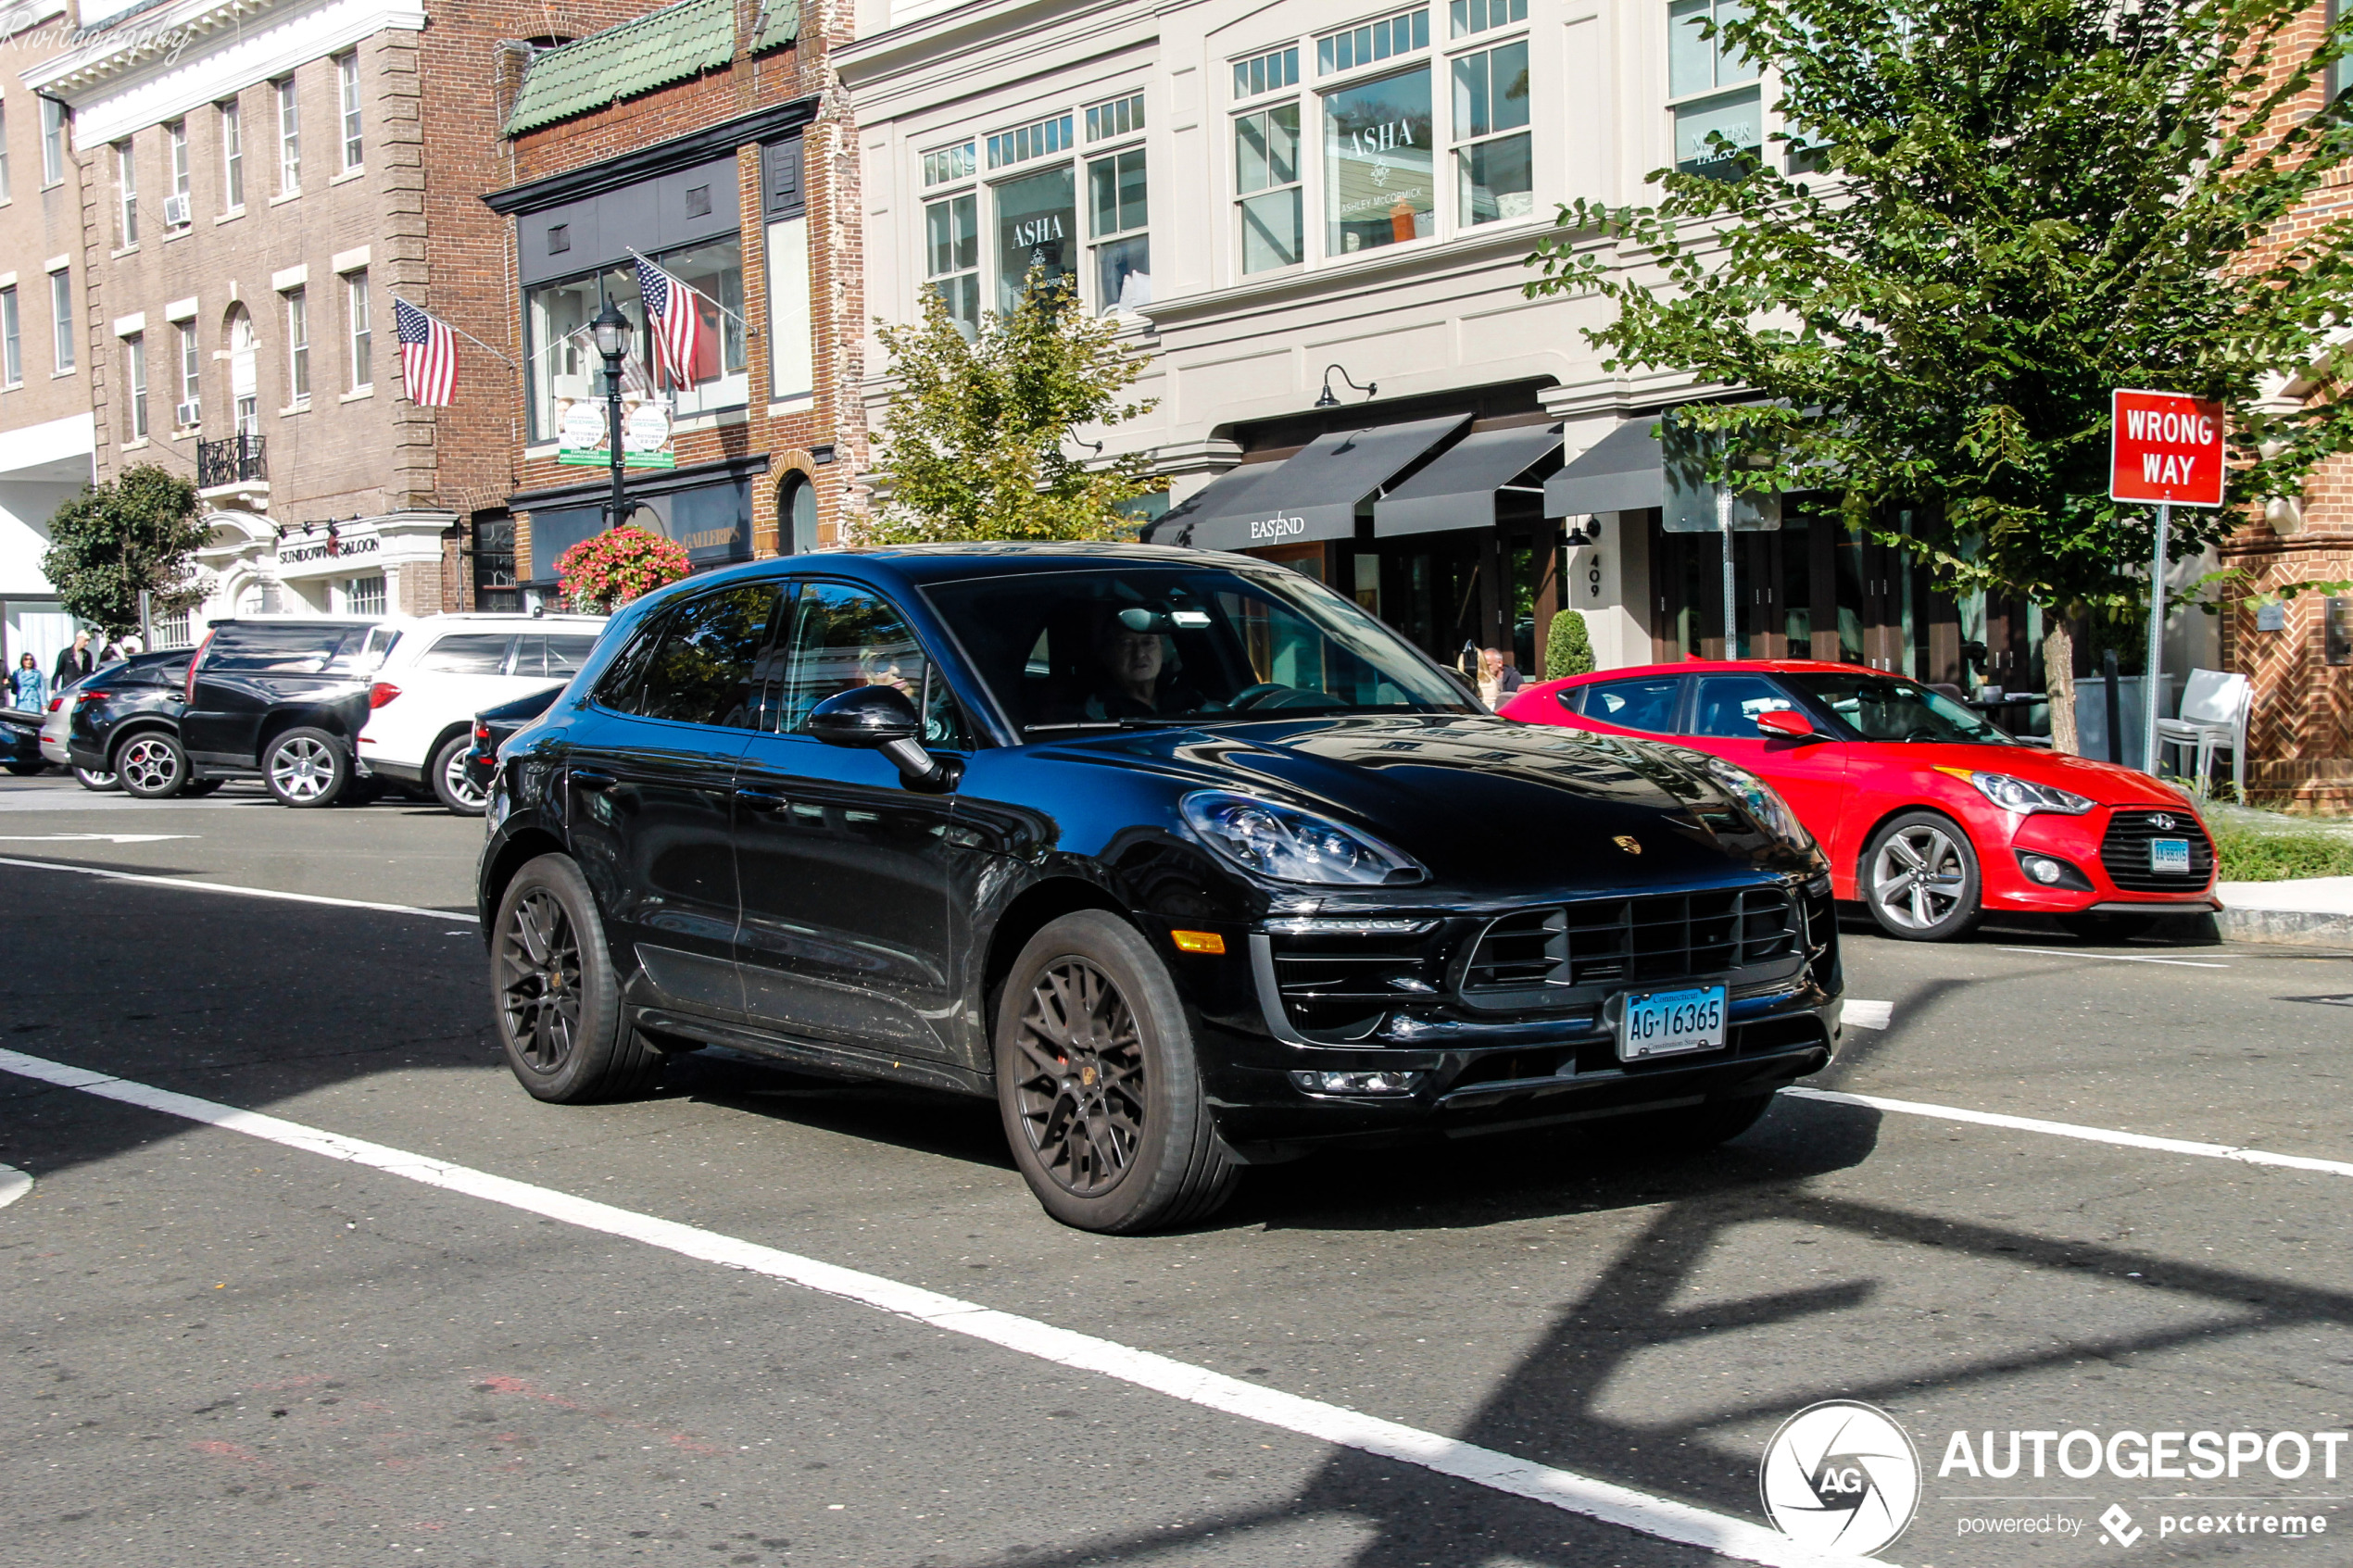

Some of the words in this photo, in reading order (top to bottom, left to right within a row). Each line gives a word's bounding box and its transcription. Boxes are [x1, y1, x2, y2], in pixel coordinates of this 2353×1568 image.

[1346, 118, 1415, 159] ASHA
[1341, 199, 1371, 214] ASHLEY
[1011, 214, 1064, 249] ASHA
[2127, 409, 2213, 445] WRONG
[2143, 453, 2196, 485] WAY
[338, 536, 380, 556] SALOON
[683, 526, 741, 549] GALLERIES
[1589, 554, 1601, 597] 409
[1654, 992, 1698, 1004] Connecticut
[1648, 1039, 1683, 1050] Constitution
